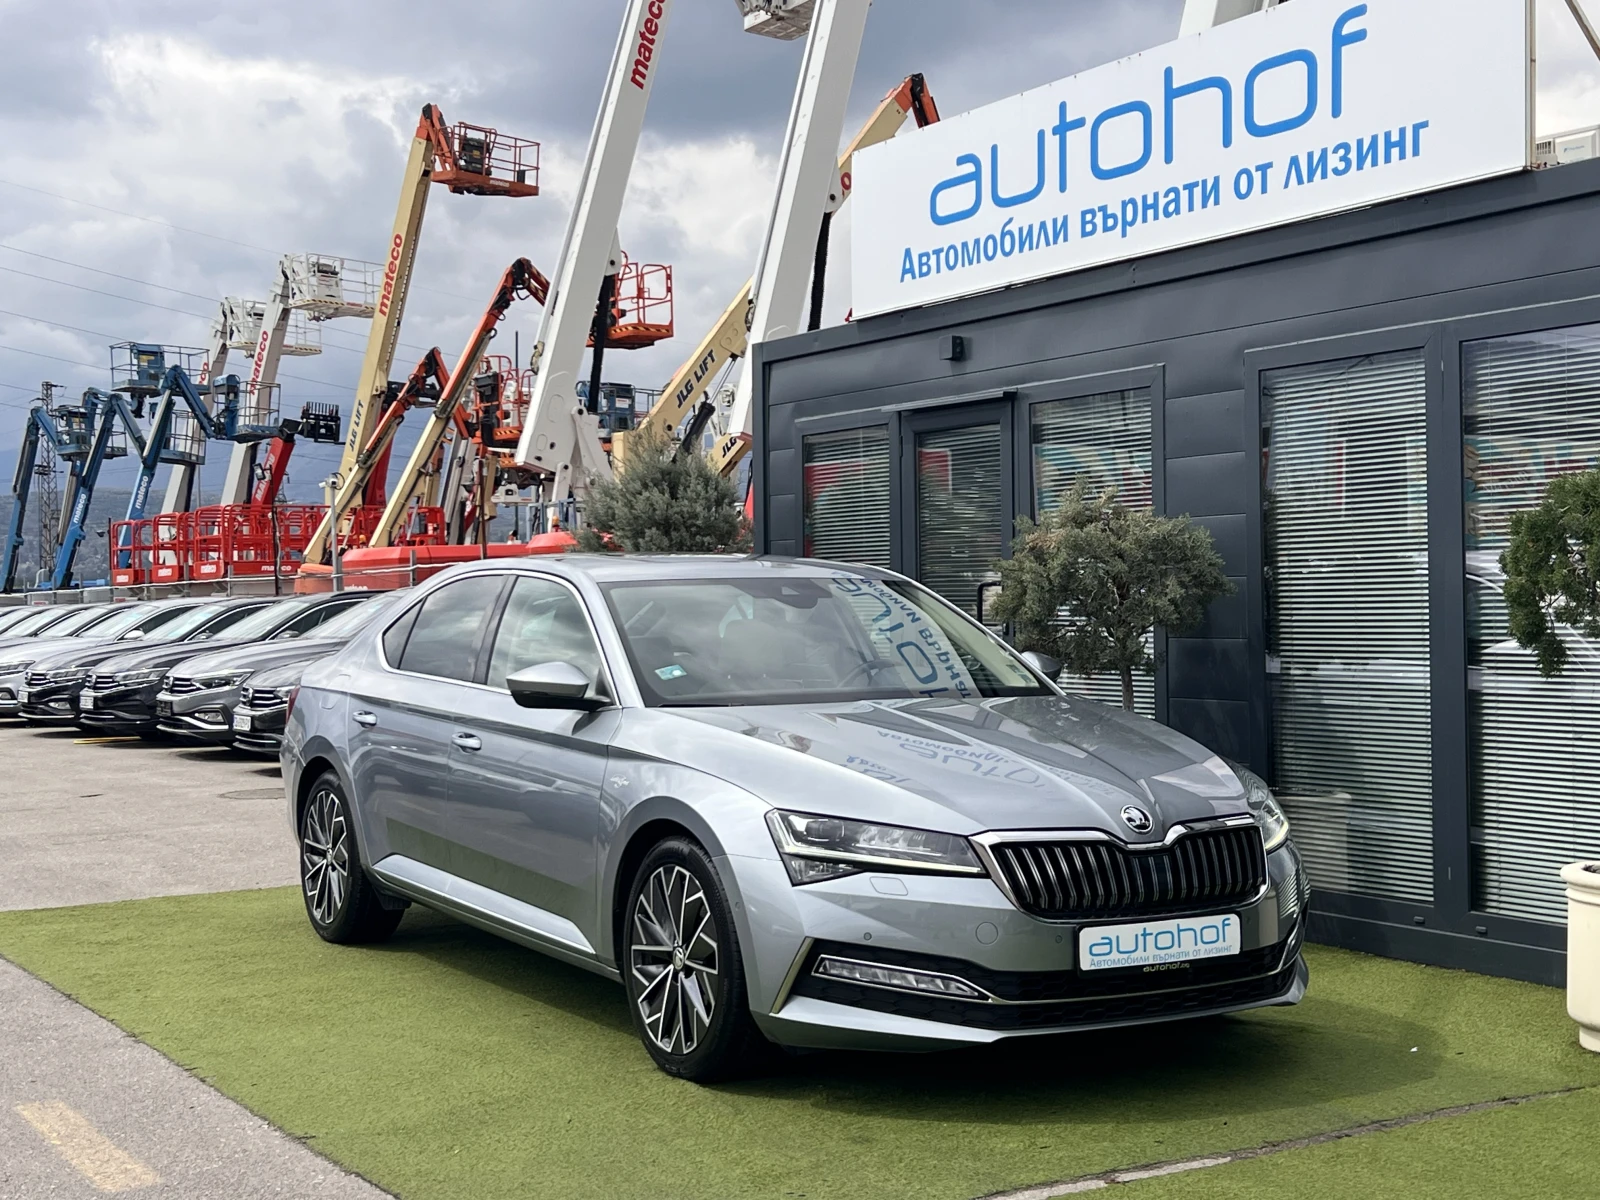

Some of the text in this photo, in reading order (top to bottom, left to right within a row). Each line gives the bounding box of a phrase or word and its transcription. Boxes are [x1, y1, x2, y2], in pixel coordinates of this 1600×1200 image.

[630, 0, 666, 90] matec
[930, 4, 1368, 227] autohof
[900, 119, 1430, 283] Автомобили върнати от лизинг
[378, 233, 403, 317] mateco
[675, 348, 716, 409] JLG LIFT
[349, 399, 364, 452] JLG LIFT
[722, 436, 737, 458] JLG
[73, 493, 87, 524] mateco
[135, 475, 149, 509] mateco
[1089, 917, 1231, 957] autohof
[1089, 944, 1233, 968] Автомобили върнати от лизинг
